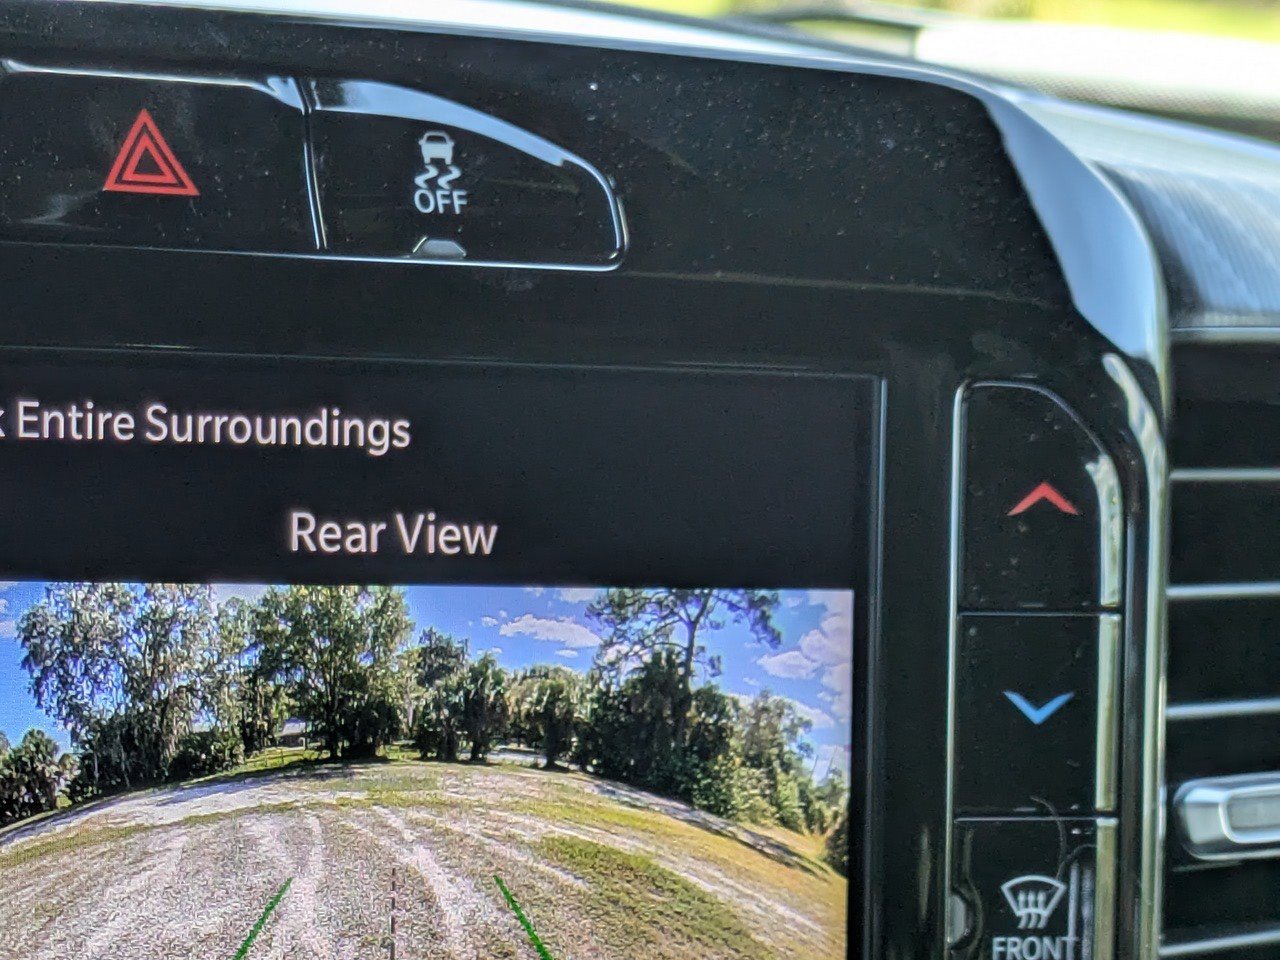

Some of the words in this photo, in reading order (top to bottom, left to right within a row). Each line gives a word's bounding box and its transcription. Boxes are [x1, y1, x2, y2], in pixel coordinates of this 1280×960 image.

[414, 189, 468, 215] OFF
[19, 401, 136, 442] Entire
[145, 404, 411, 456] Surroundings
[289, 512, 387, 555] Rear
[394, 513, 499, 557] View
